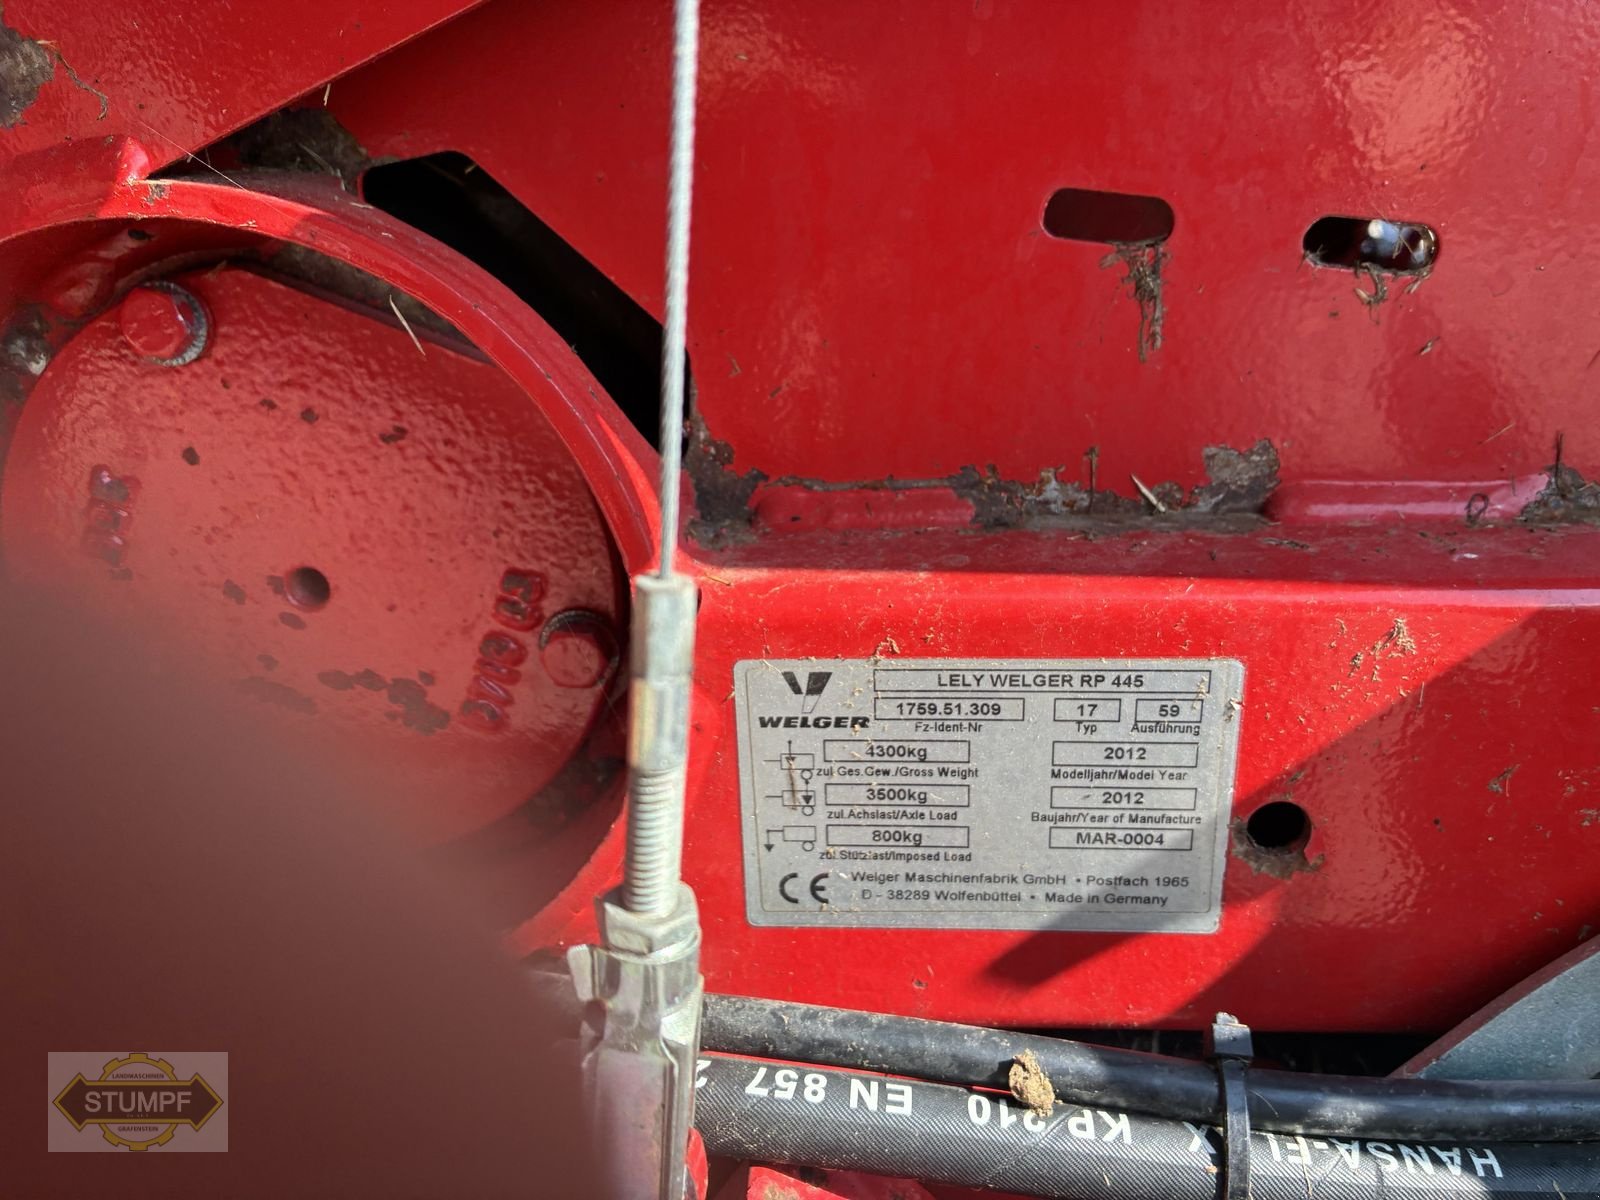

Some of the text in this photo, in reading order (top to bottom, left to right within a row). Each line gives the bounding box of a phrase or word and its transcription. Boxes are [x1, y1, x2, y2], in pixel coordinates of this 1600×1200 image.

[937, 674, 1144, 688] LELY WELGER RP 445
[896, 702, 1001, 716] 1759.51.309
[1077, 704, 1098, 717] 17
[1158, 704, 1180, 717] 59
[758, 715, 870, 729] WELGER
[914, 722, 983, 733] Fz-Ident-Nr
[1076, 722, 1098, 735] Typ
[1130, 722, 1200, 736] Ausführung
[865, 745, 927, 762] 4300kg
[1103, 747, 1147, 760] 2012
[937, 766, 979, 780] Weight
[1158, 770, 1188, 780] Year
[866, 788, 928, 804] 3500kg
[1101, 792, 1145, 804] 2012
[929, 810, 958, 820] Load
[1112, 812, 1124, 822] of
[1128, 813, 1202, 824] Manufacture
[872, 830, 923, 846] 800kg
[1075, 832, 1164, 846] MAR-0004
[944, 851, 972, 862] Load
[851, 872, 1190, 888] Welger Maschinenfabrik GmbH Postfach 1965
[861, 889, 872, 900] D
[887, 889, 930, 900] 38289
[934, 890, 1022, 902] Wolfenbüttel
[1045, 892, 1083, 904] Made
[1087, 892, 1100, 904] in
[1104, 893, 1168, 907] Germany
[745, 1066, 827, 1103] 857
[848, 1079, 914, 1116] EN
[1067, 1108, 1132, 1145] KP
